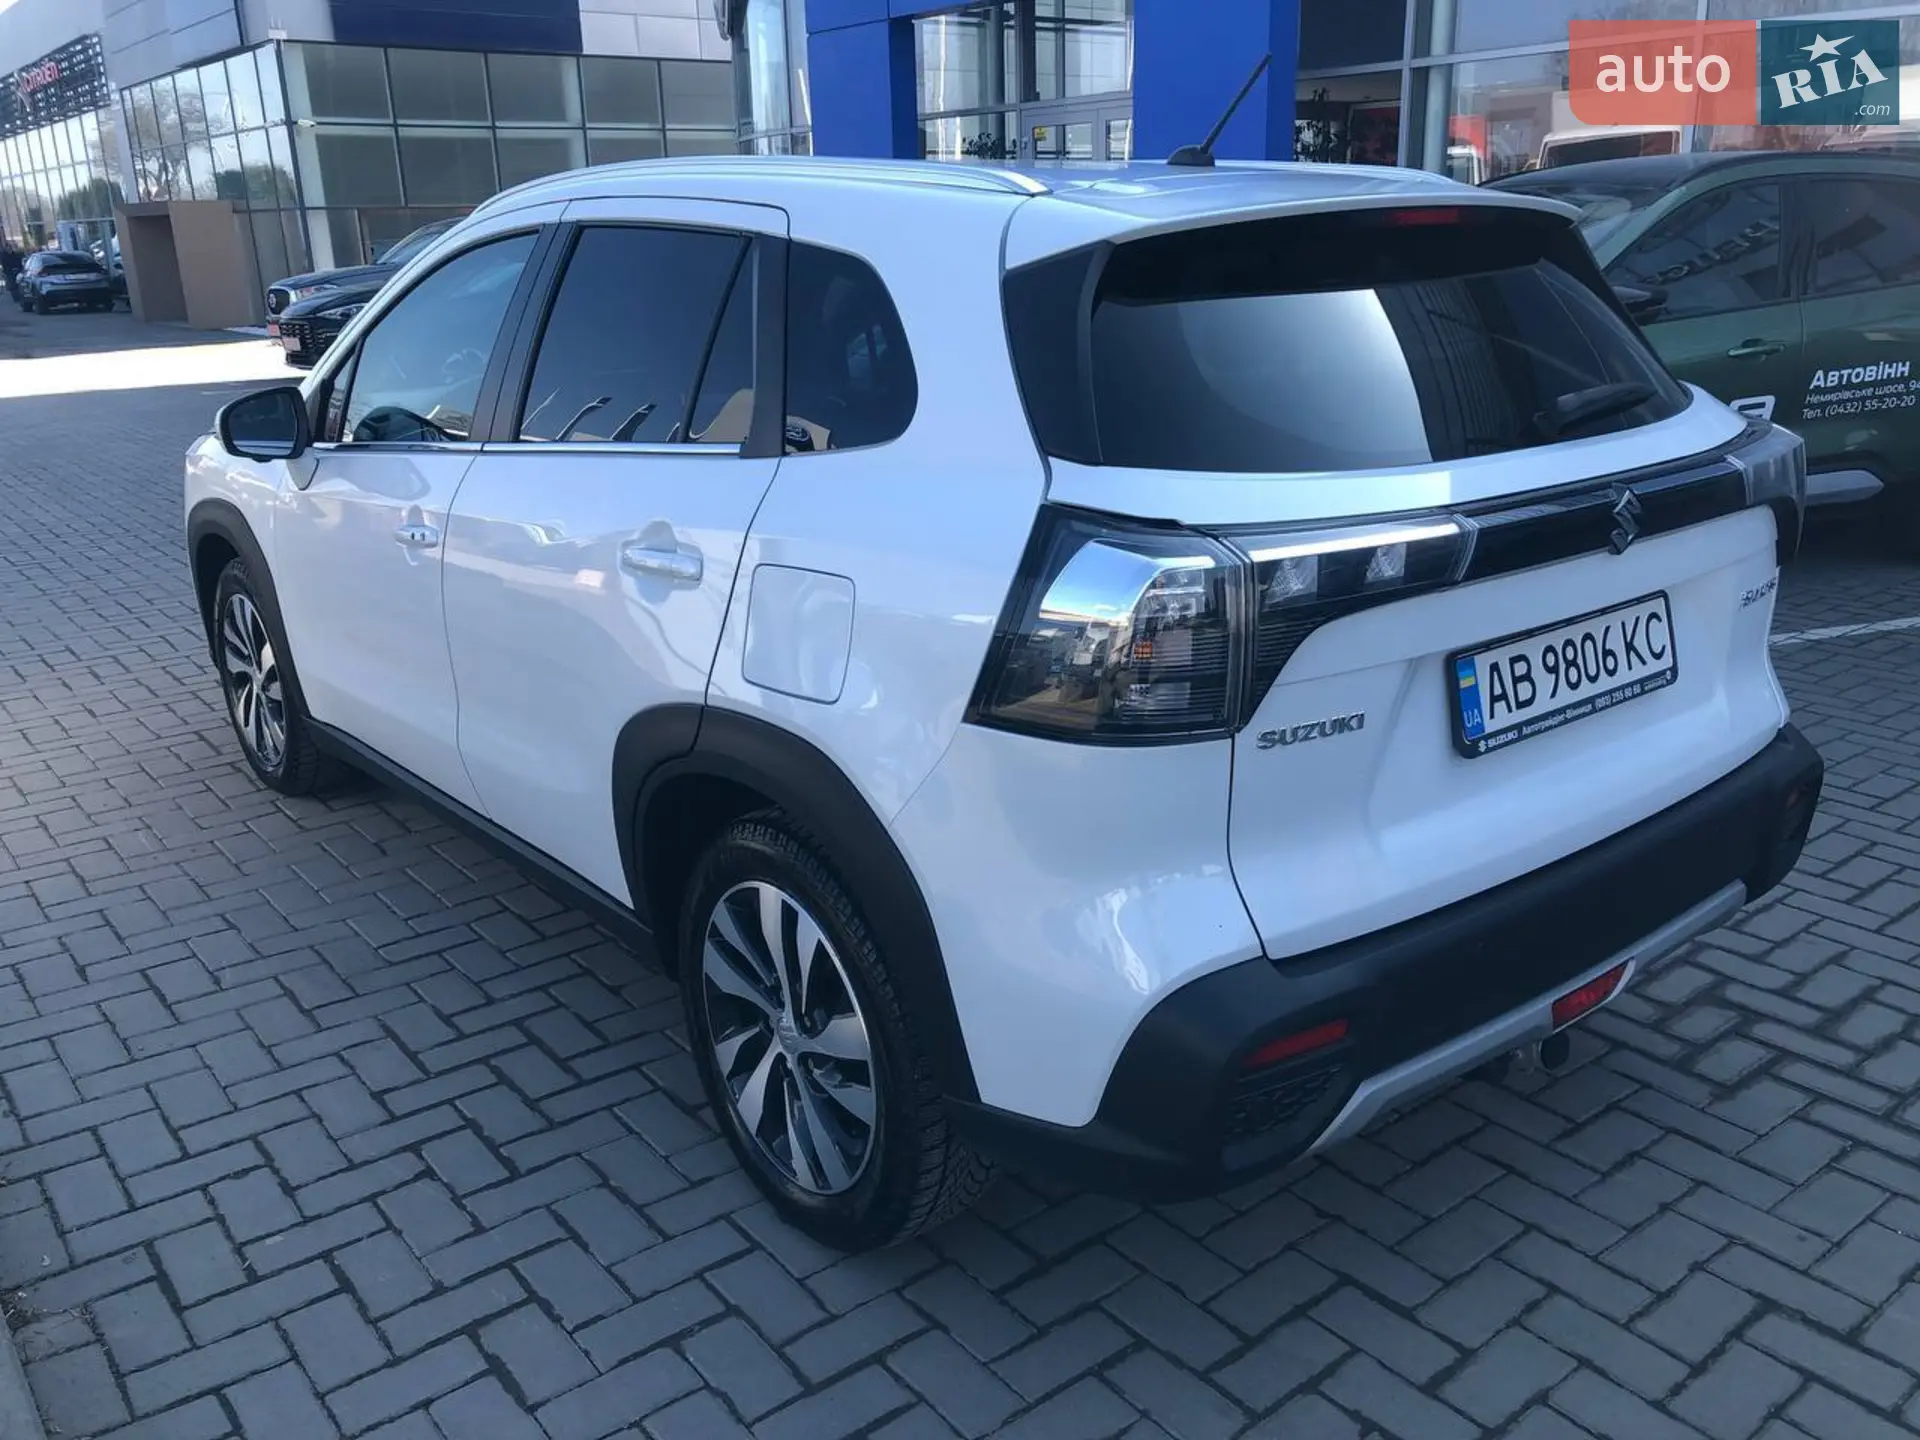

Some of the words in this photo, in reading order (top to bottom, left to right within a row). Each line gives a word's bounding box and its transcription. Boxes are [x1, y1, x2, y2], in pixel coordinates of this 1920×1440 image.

[1809, 361, 1911, 389] Автовінн
[1824, 400, 1863, 418] (0432)
[1864, 395, 1916, 411] 55-20-20
[1488, 653, 1537, 720] AB
[1541, 624, 1619, 699] 9806
[1621, 611, 1667, 671] KC
[1256, 711, 1366, 749] SUZUKI
[1464, 710, 1483, 728] UA
